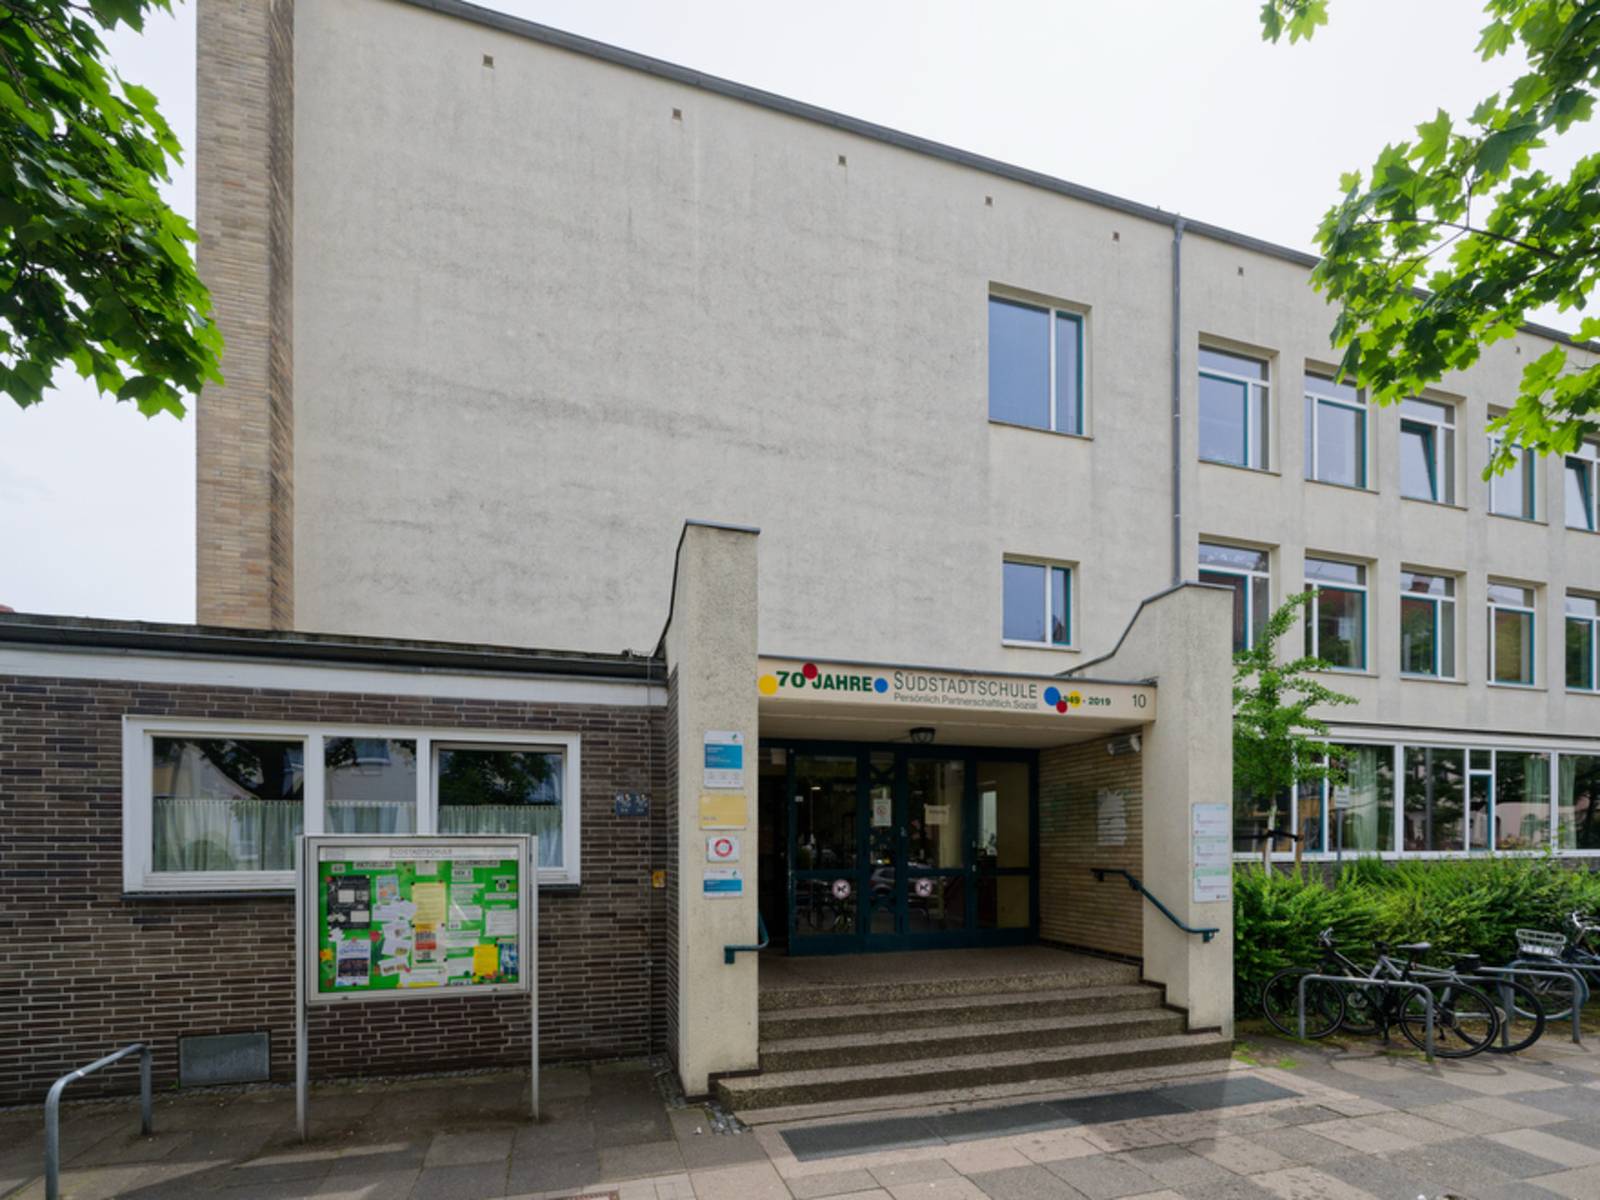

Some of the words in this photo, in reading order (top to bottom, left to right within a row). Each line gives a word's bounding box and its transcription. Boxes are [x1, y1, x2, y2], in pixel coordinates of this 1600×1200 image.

[776, 670, 805, 688] 70
[811, 673, 873, 692] JAHRE
[894, 692, 940, 704] Persönlich
[1013, 699, 1038, 709] Sozial
[1088, 696, 1111, 706] 2019
[1132, 693, 1146, 708] 10
